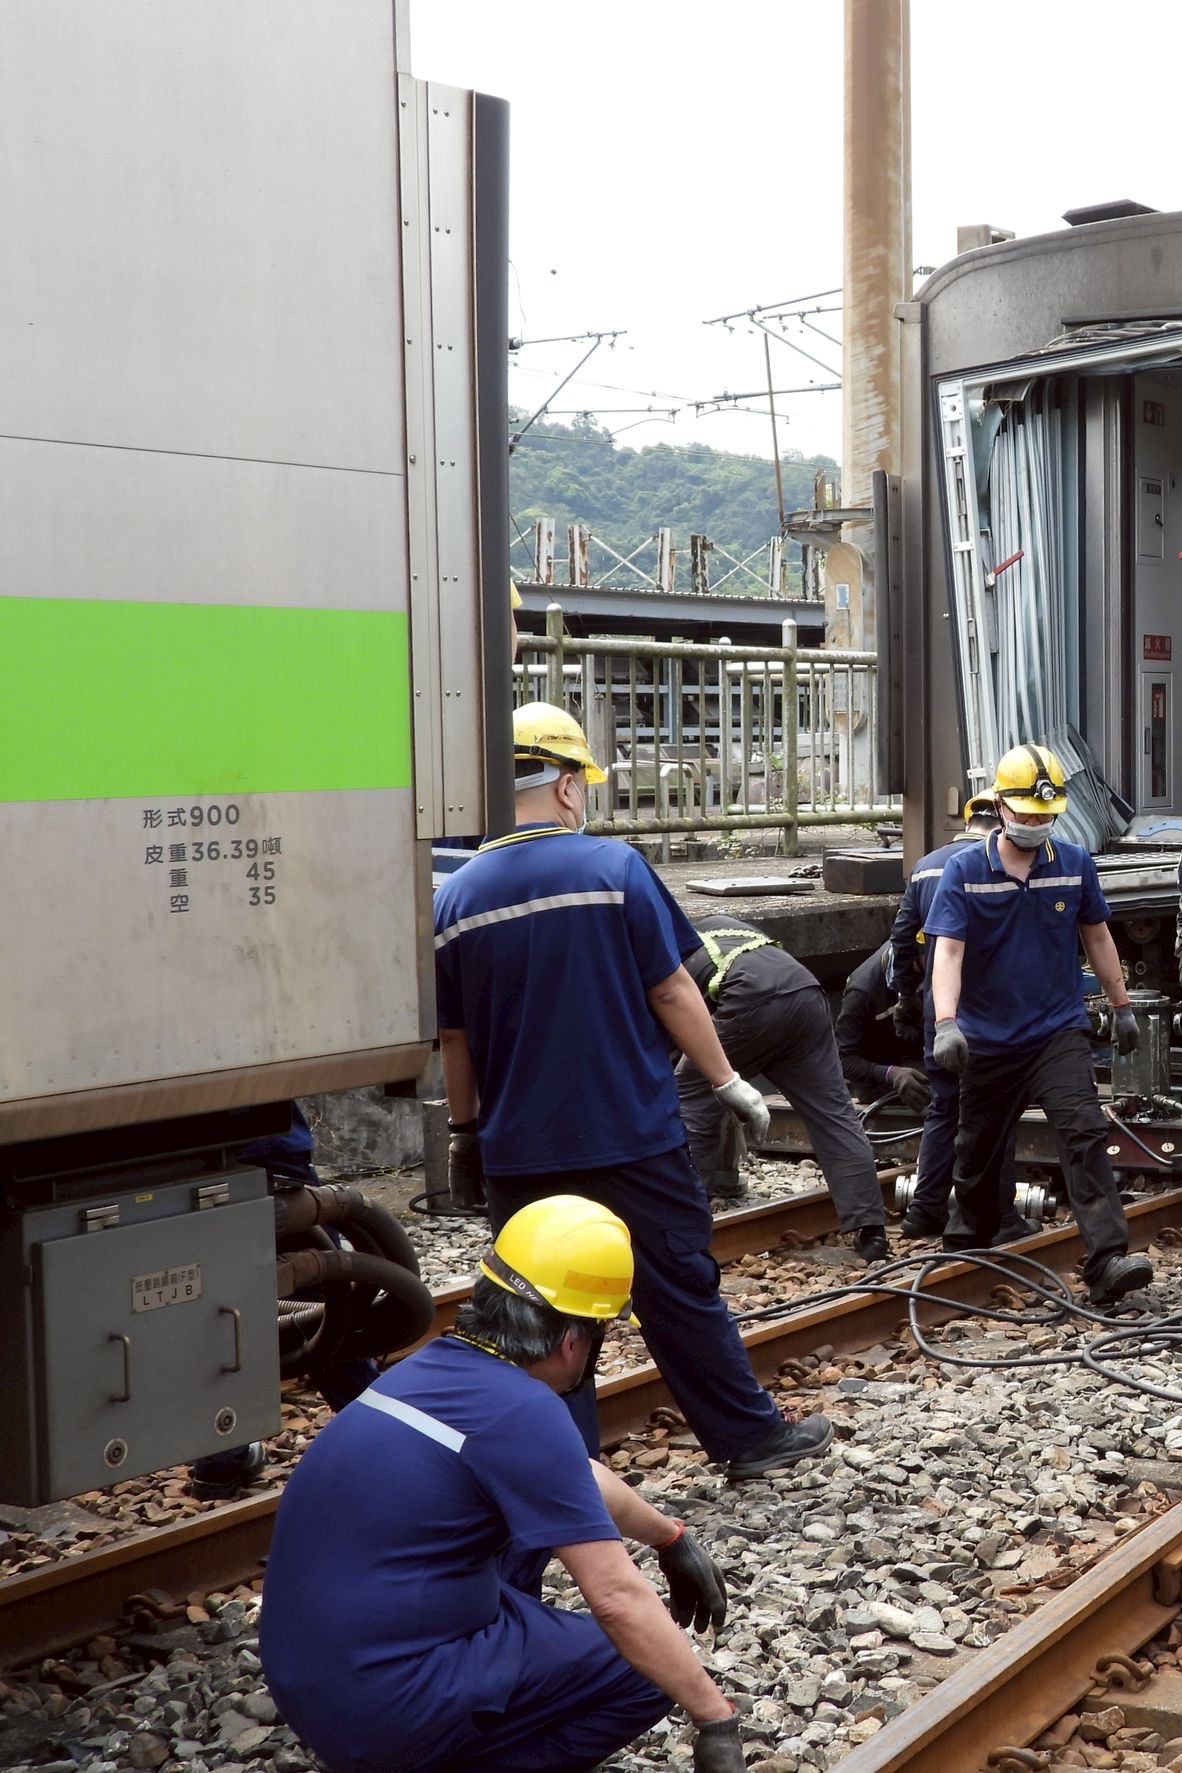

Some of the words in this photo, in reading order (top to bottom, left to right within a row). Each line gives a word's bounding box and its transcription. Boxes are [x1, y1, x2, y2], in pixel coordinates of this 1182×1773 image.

[143, 804, 240, 828] 形式900
[144, 837, 282, 864] 皮重36.39噸
[169, 868, 188, 888] 重
[246, 862, 275, 881] 45
[170, 894, 189, 913] 空
[249, 886, 276, 906] 35
[509, 1274, 526, 1290] LED
